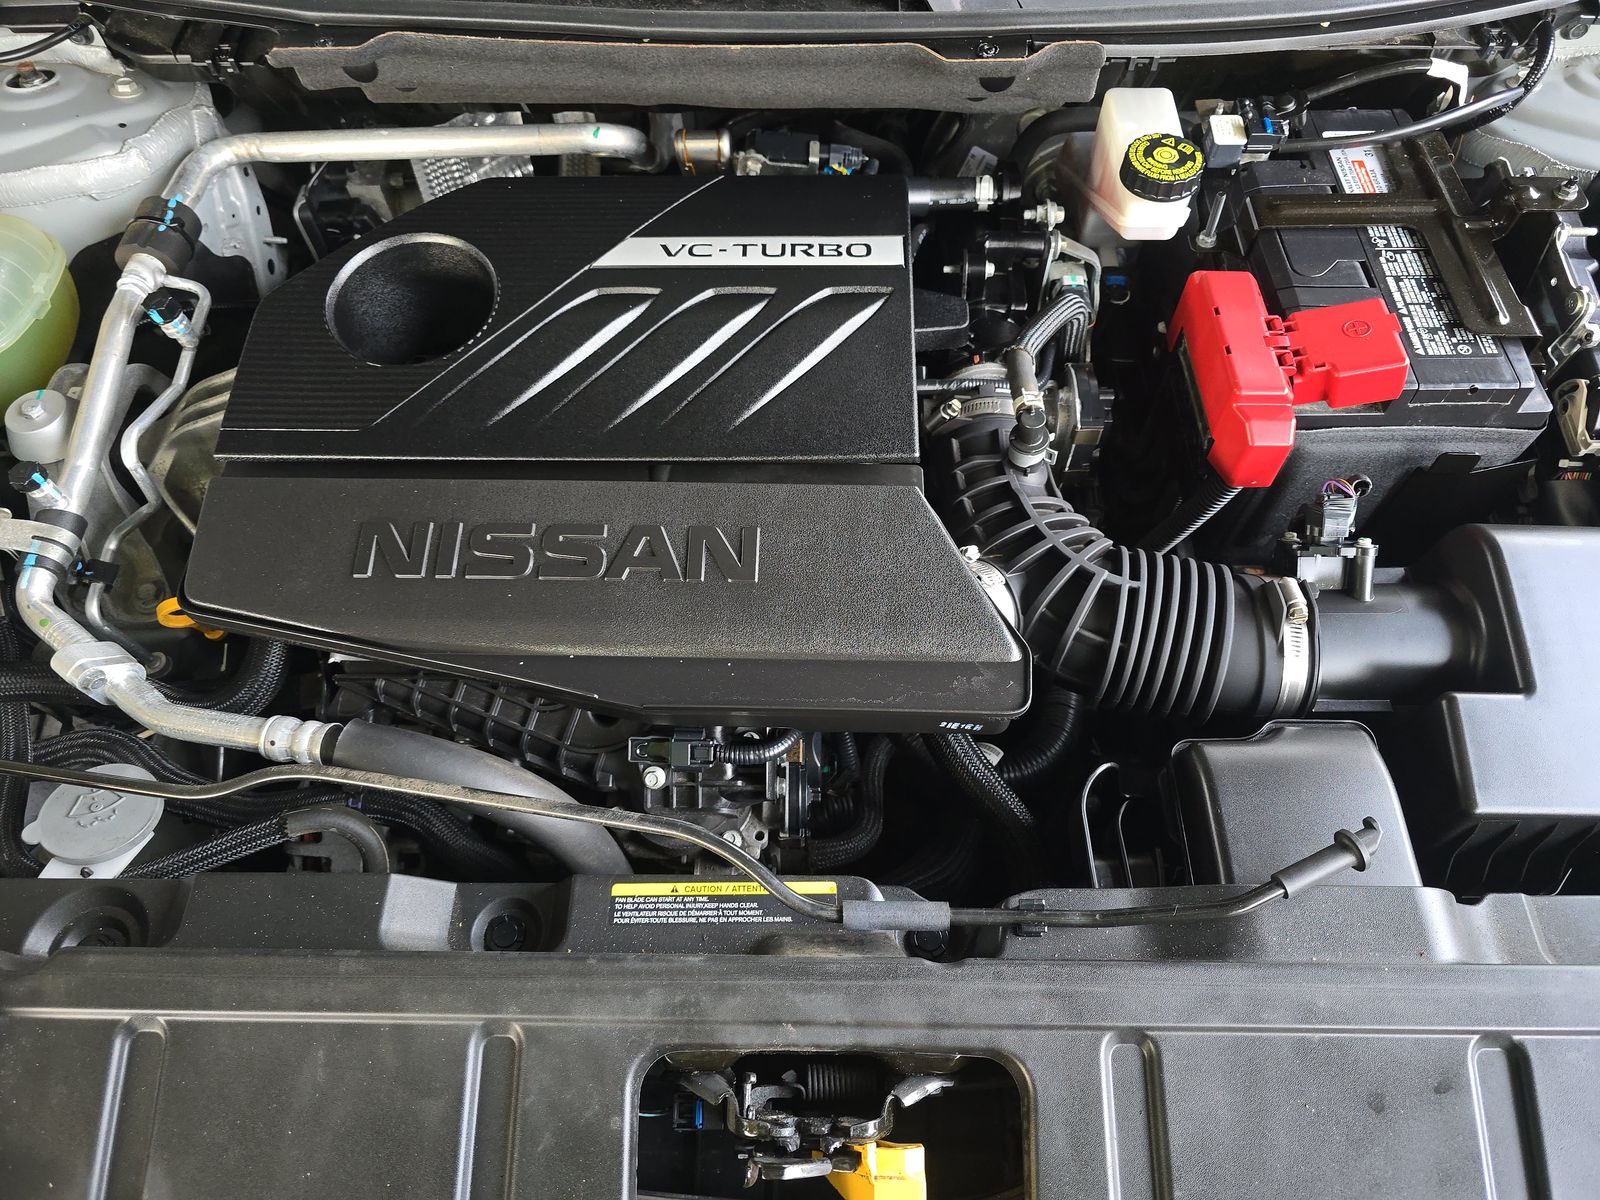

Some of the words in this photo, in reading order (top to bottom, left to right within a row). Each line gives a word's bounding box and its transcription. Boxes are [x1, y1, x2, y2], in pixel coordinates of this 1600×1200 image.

[659, 242, 873, 258] VC-TURBO
[352, 521, 762, 584] NISSAN
[684, 885, 722, 893] CAUTION
